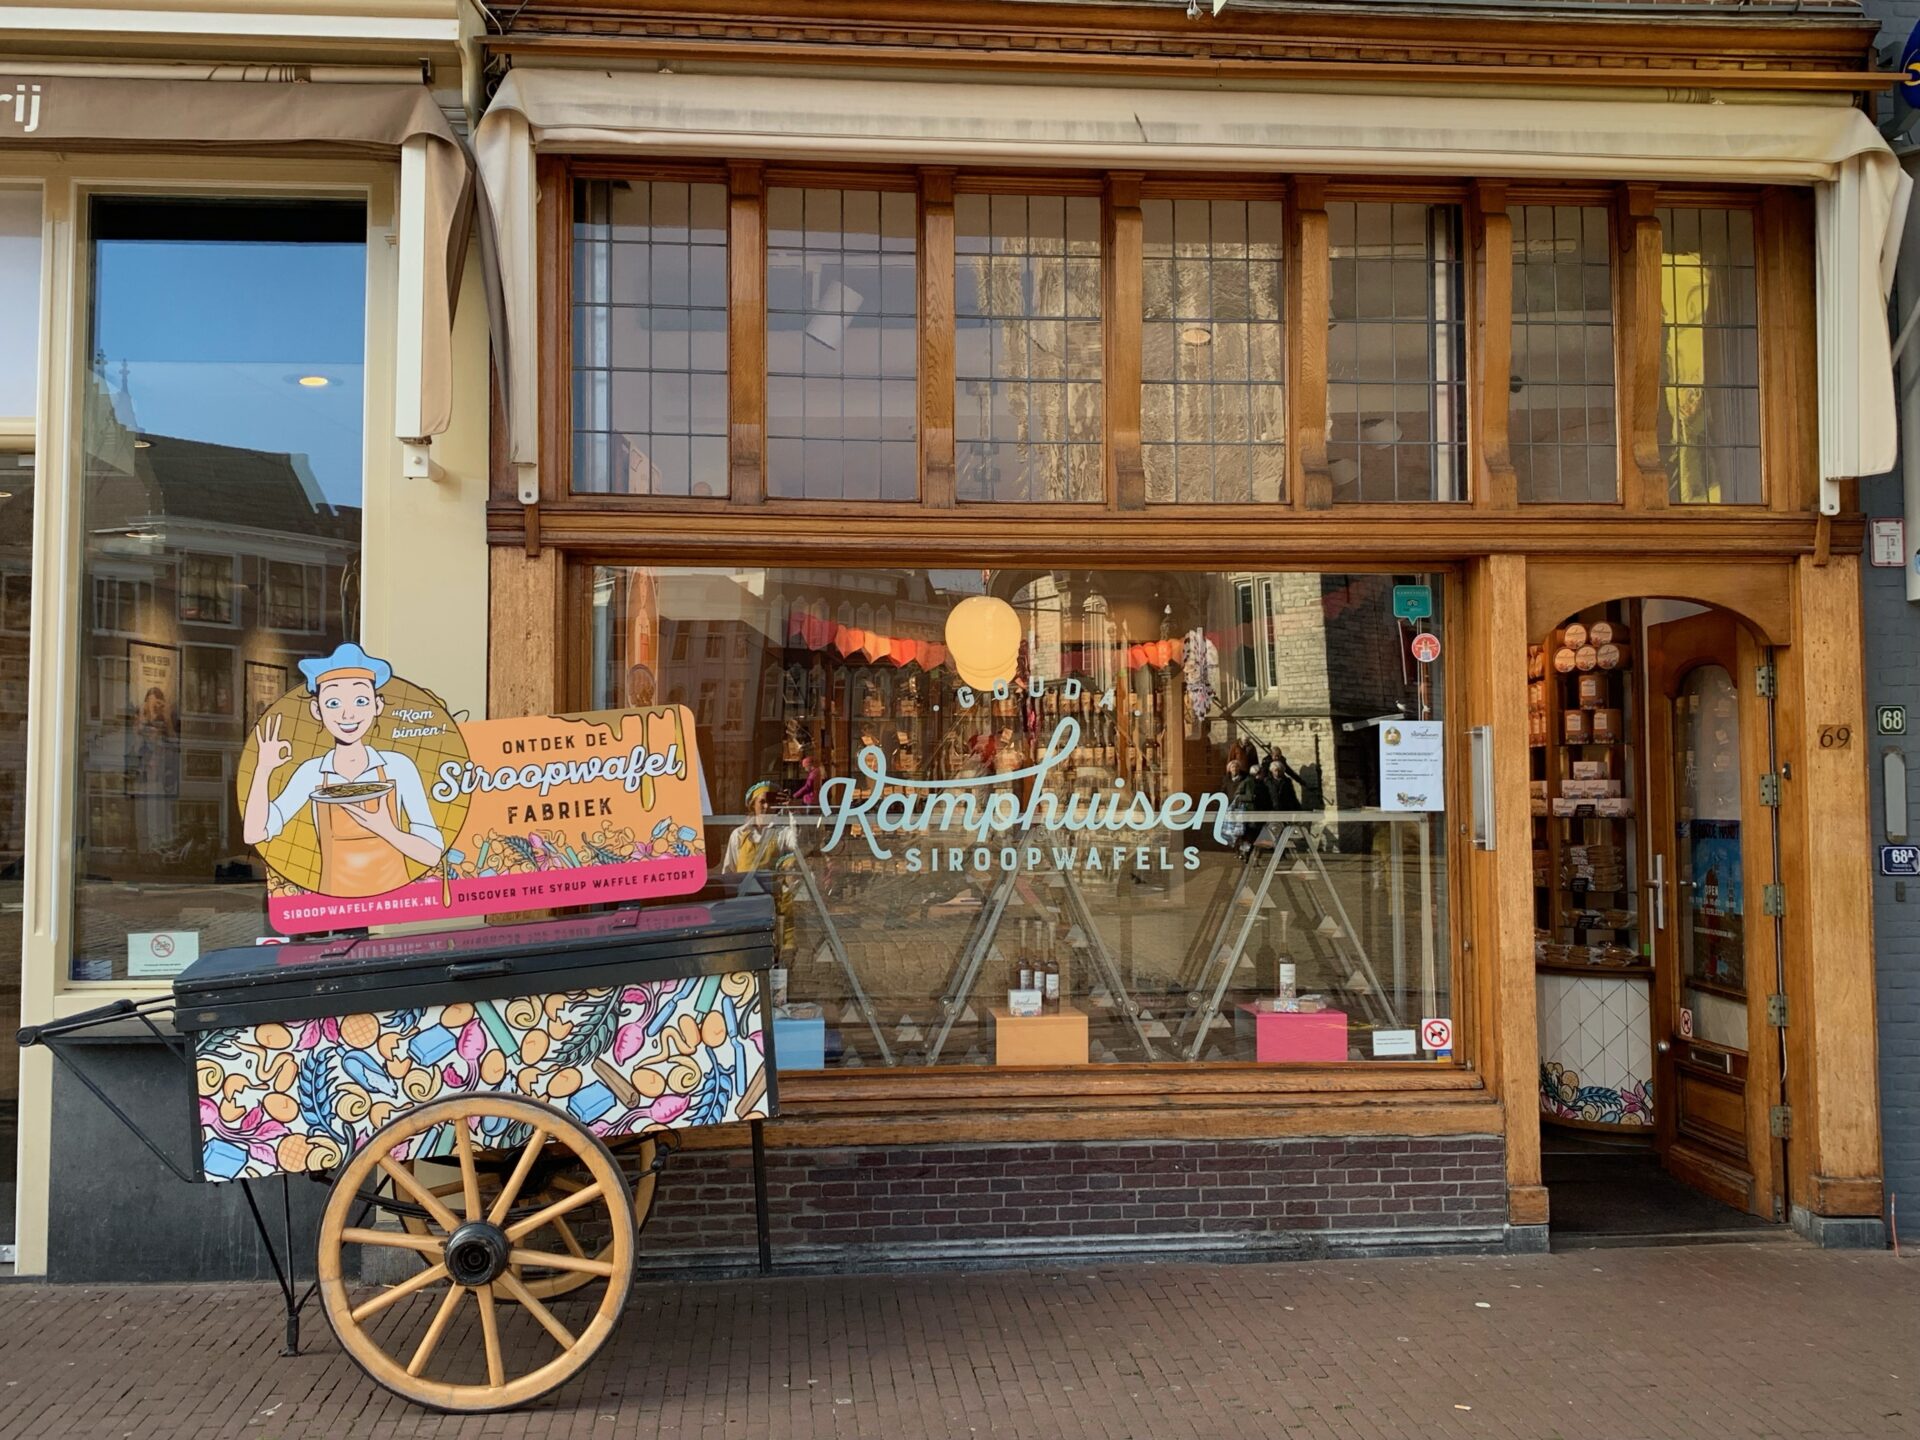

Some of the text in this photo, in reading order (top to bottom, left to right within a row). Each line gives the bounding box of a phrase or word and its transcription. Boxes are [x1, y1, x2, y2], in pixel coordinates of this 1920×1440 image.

[1882, 710, 1903, 730] 68
[503, 732, 608, 754] ONTDEK DE
[1820, 727, 1851, 748] 69
[431, 744, 683, 803] Siroopwafel
[819, 716, 1229, 860] Kamphuisen
[507, 797, 613, 825] FABRIEK
[906, 846, 1200, 872] SIROOPWAFELS
[1892, 849, 1915, 864] 68A
[458, 870, 696, 902] DISCOVER THE SYRUP WAFFLE FACTORY
[283, 896, 439, 920] SIROOPWAFELFABRIEK.NL
